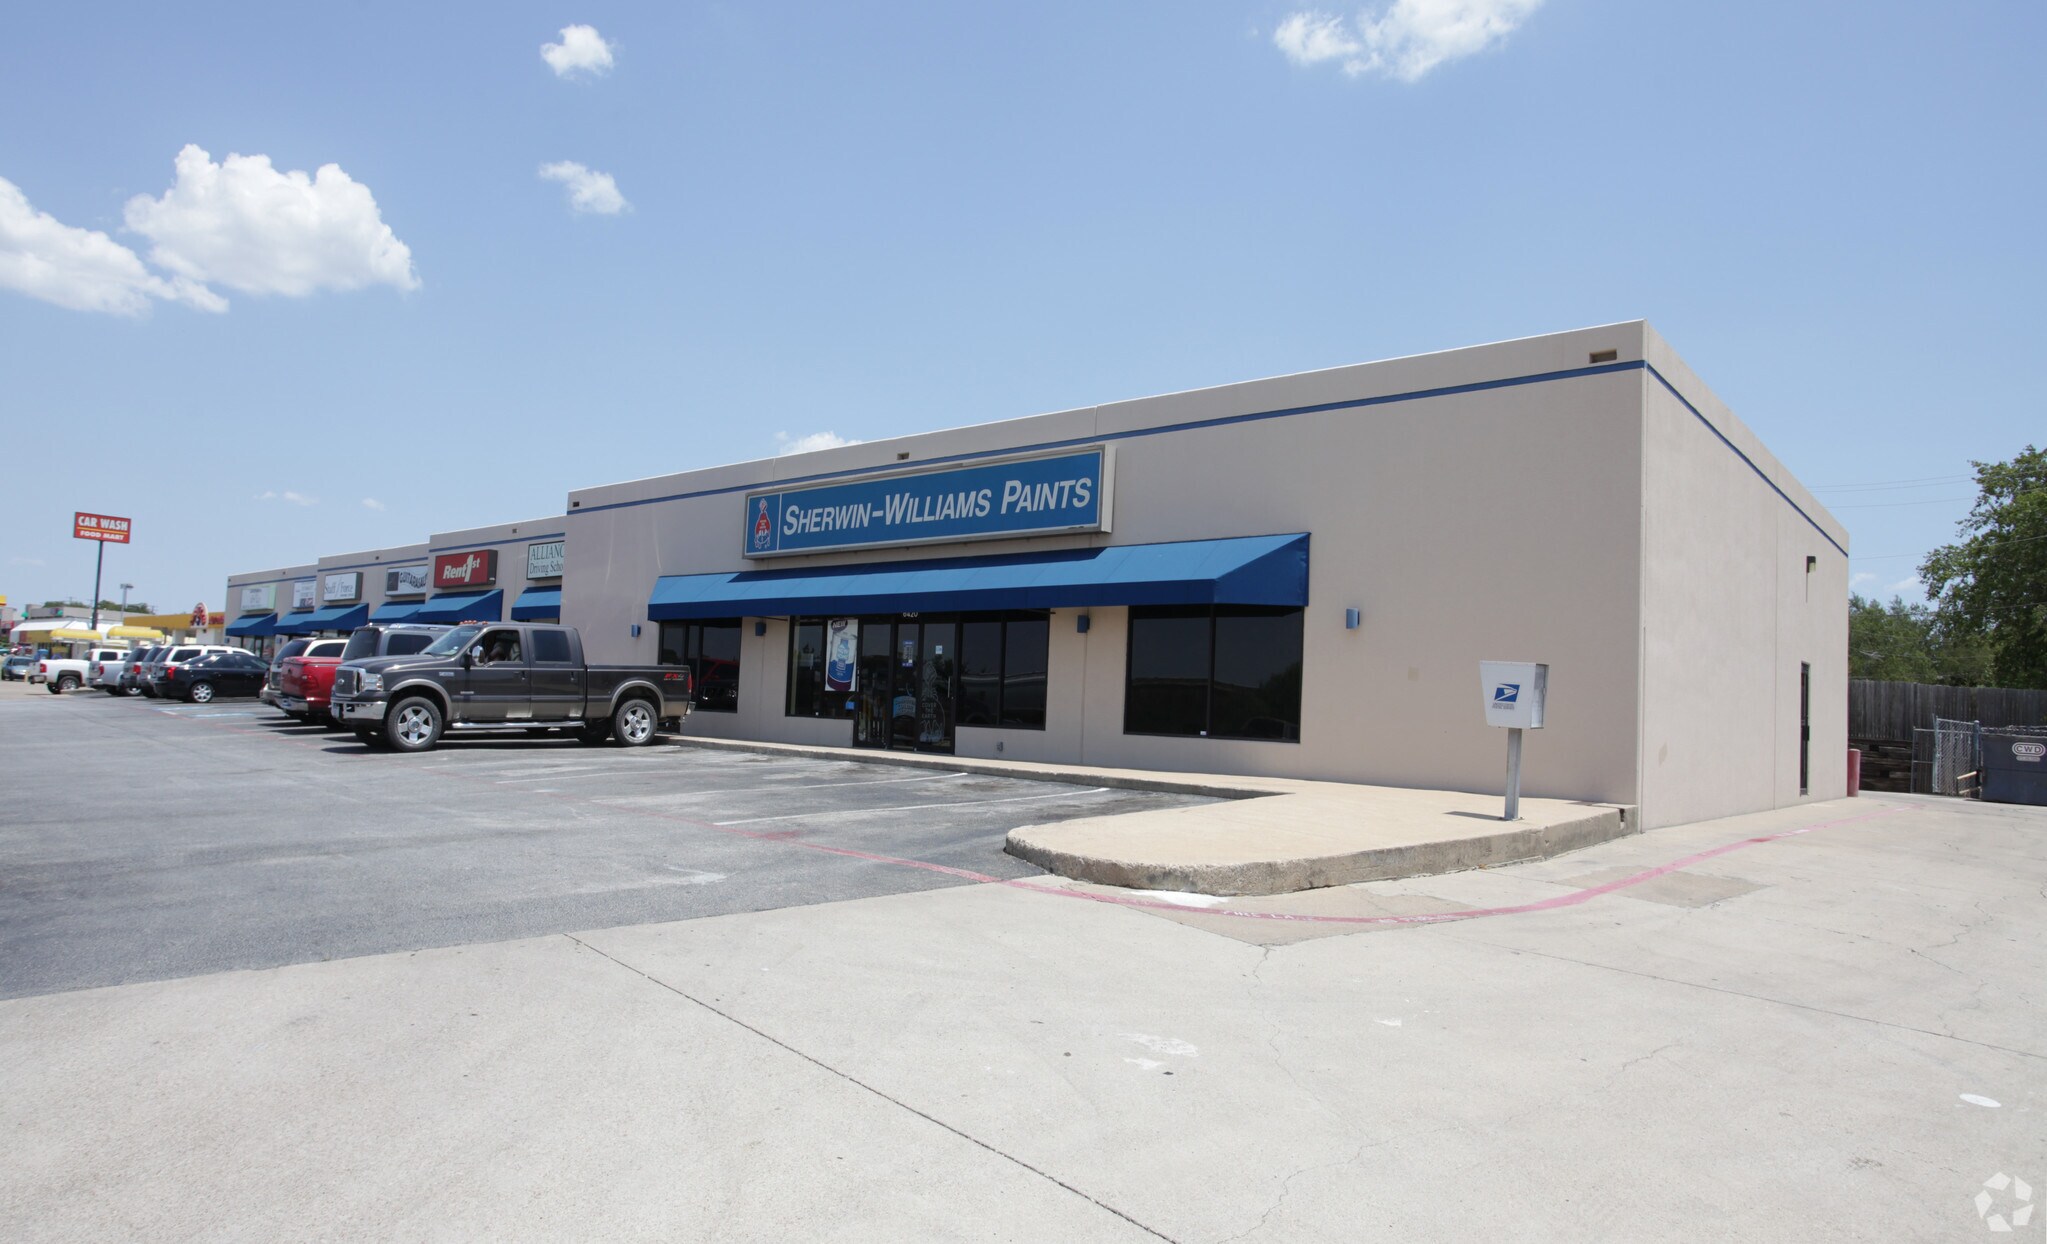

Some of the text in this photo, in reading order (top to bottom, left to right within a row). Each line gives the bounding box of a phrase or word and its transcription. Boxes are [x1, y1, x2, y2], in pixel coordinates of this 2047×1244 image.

[783, 488, 992, 536] SHERWIN-WILLIAMS
[1000, 477, 1092, 515] PAINTS
[78, 516, 129, 531] CAR WASH
[80, 530, 125, 540] FOOD MART
[832, 619, 847, 629] NEW
[2016, 745, 2042, 753] CWD
